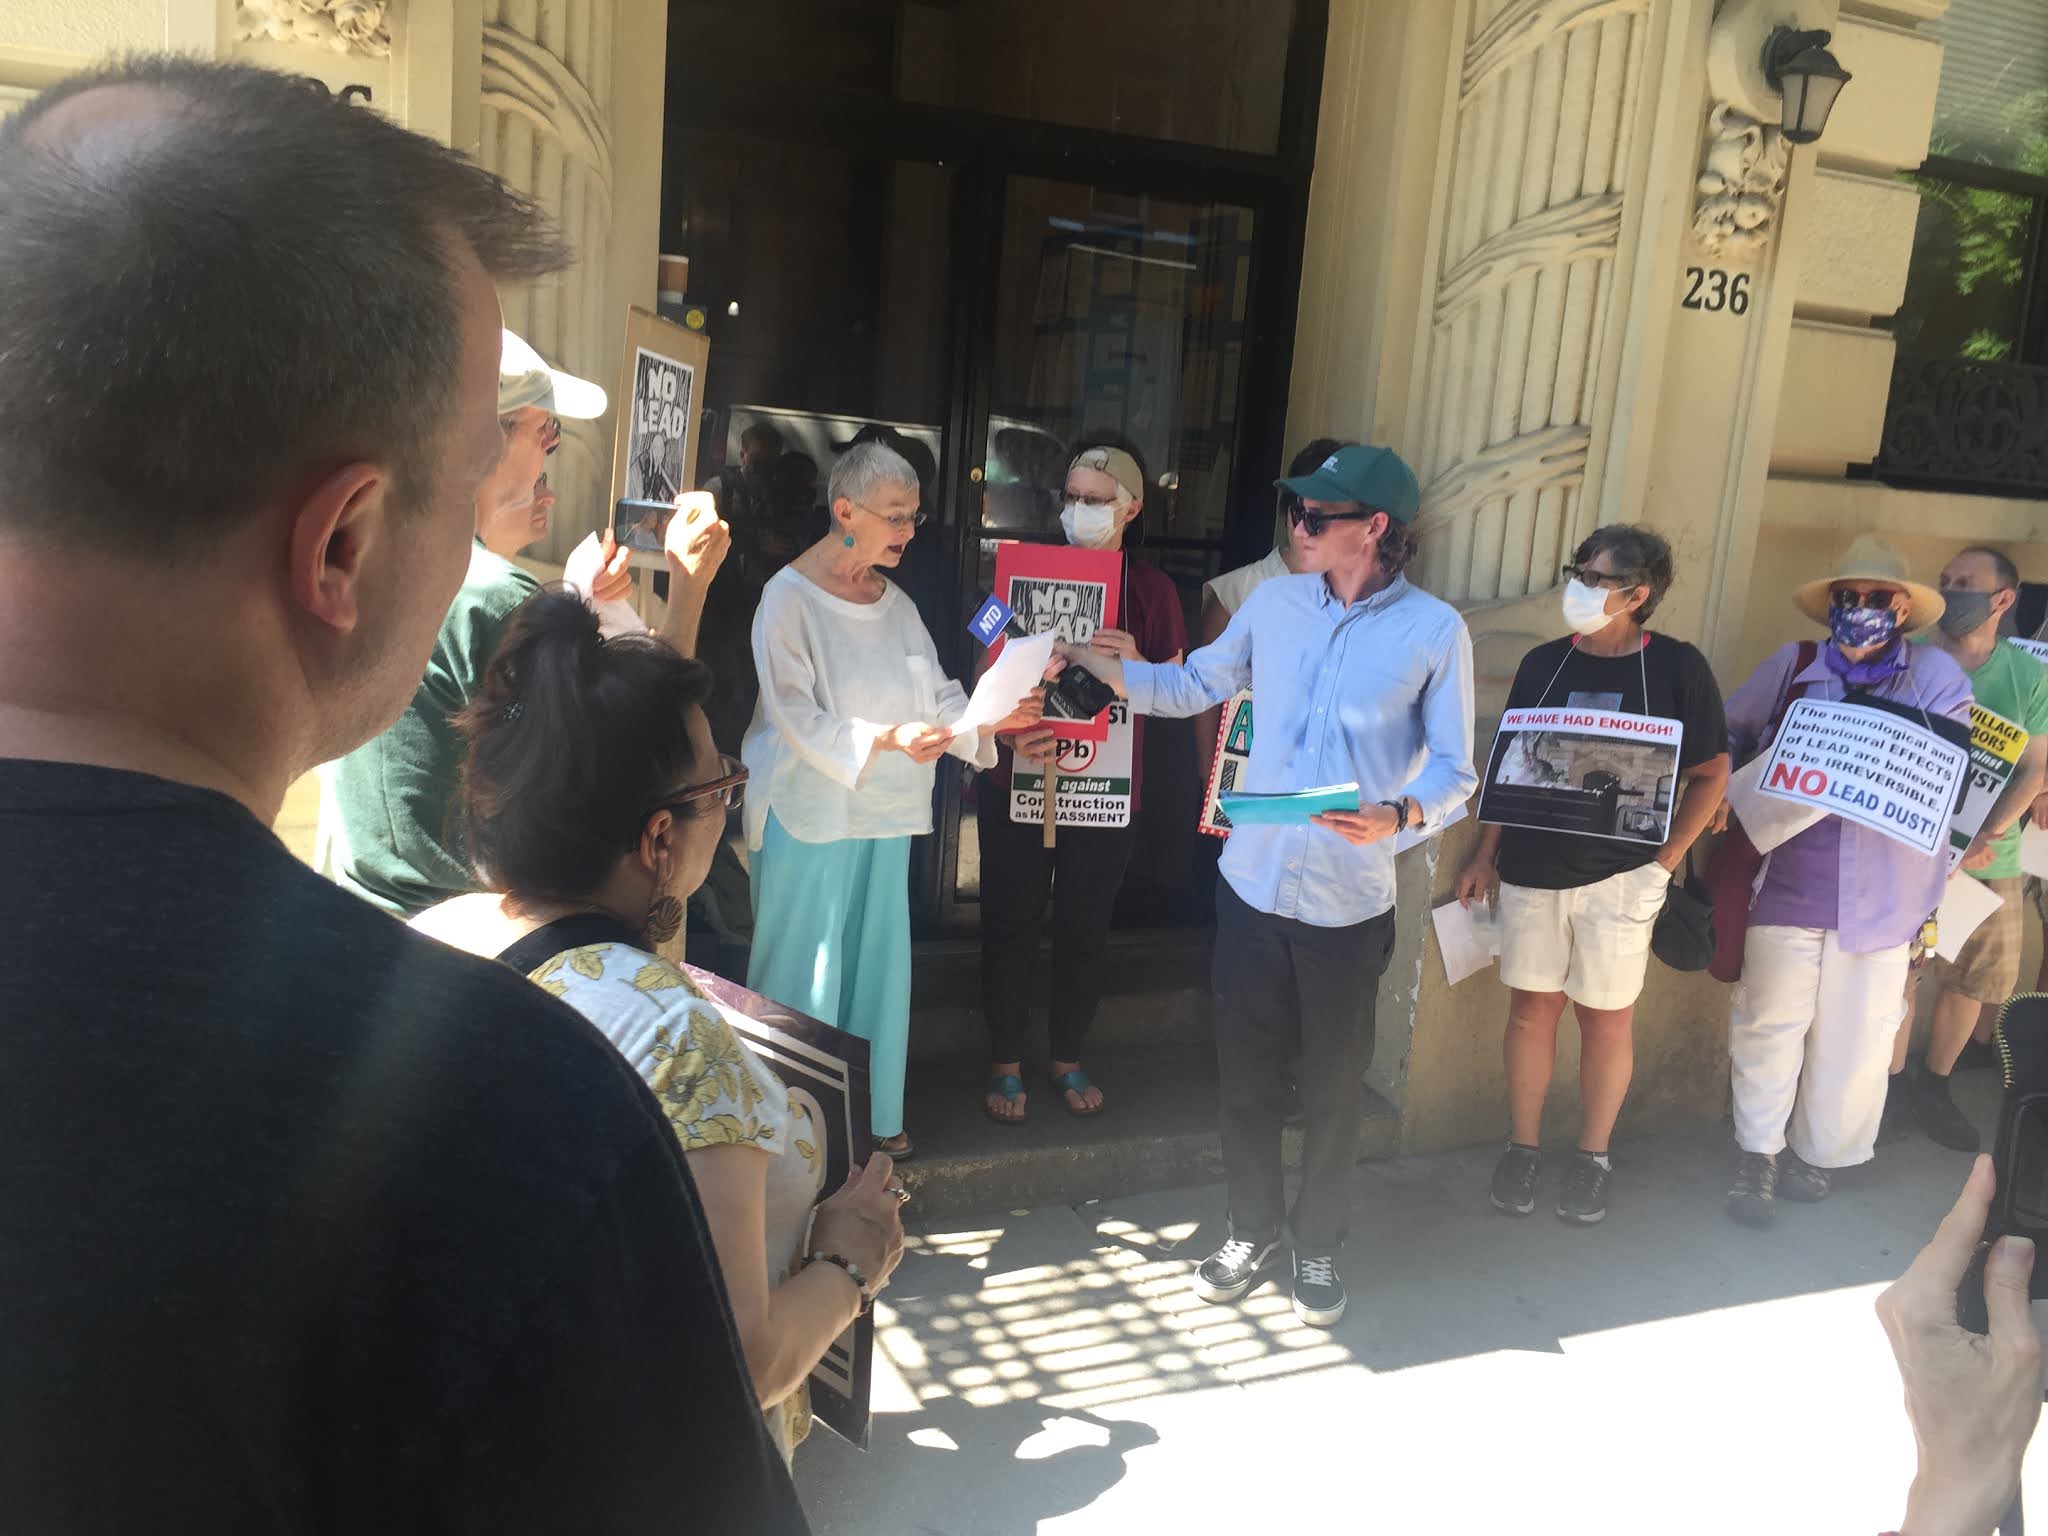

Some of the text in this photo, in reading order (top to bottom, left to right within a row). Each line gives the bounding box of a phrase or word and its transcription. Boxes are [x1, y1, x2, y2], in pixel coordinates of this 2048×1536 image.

[1681, 266, 1750, 316] 236
[647, 364, 677, 402] NO
[638, 399, 685, 440] LEAD
[1031, 585, 1078, 615] NO
[978, 604, 1002, 635] NTD
[1507, 713, 1674, 737] WE HAVE HAD ENOUGH!
[1800, 706, 1955, 765] The neurological and
[1969, 707, 2023, 743] VILLAGE
[1056, 739, 1089, 759] Pb
[1786, 736, 1944, 795] of LEAD are believed
[1792, 720, 1952, 781] behavioural EFFECTS
[1061, 778, 1111, 794] against
[1781, 749, 1940, 812] to be IRREVERSIBLE.
[1015, 810, 1028, 819] as
[1016, 793, 1125, 810] Contruction
[1769, 762, 1936, 839] NO LEAD DUST!
